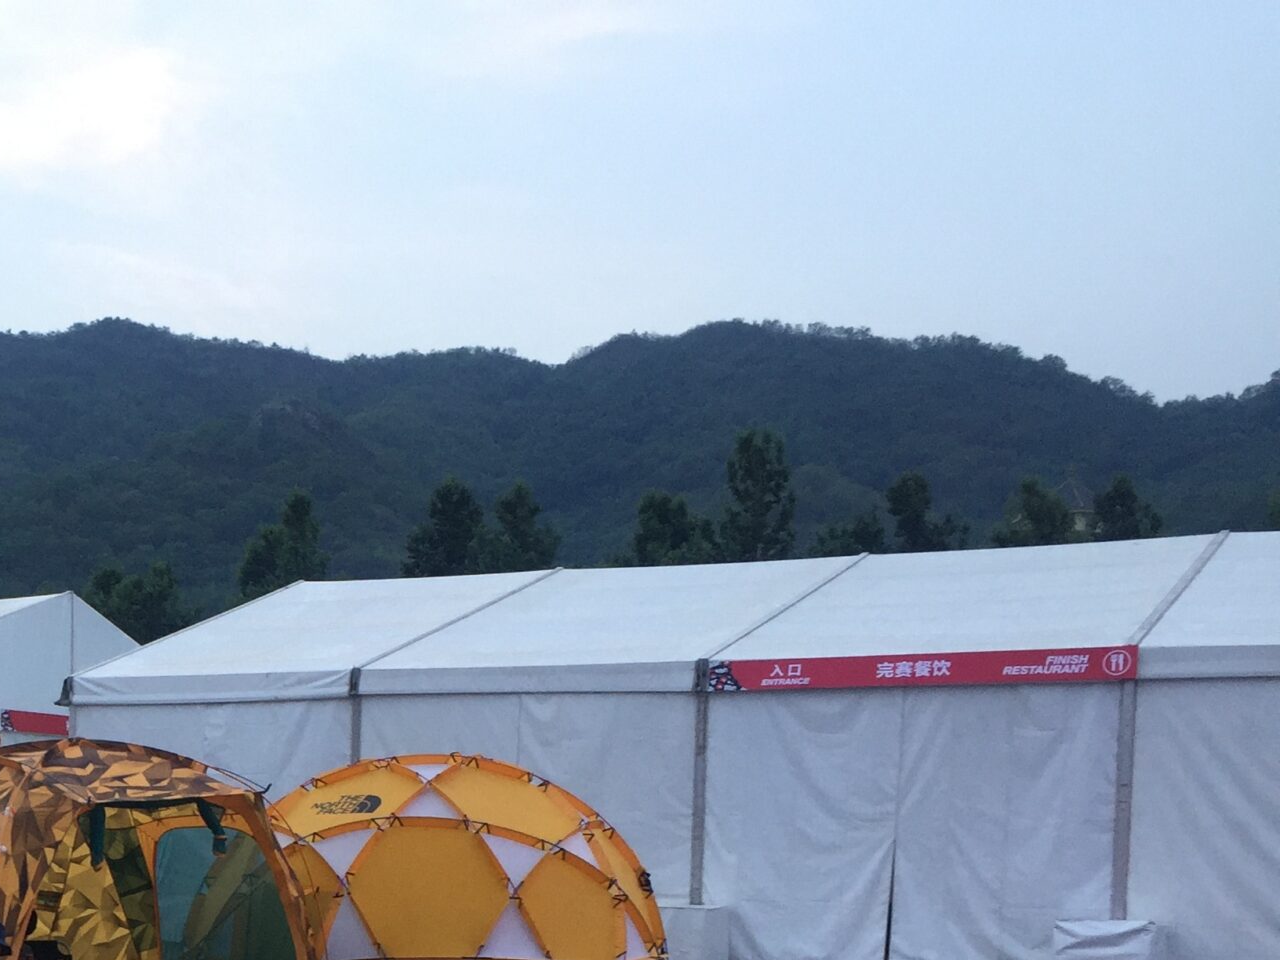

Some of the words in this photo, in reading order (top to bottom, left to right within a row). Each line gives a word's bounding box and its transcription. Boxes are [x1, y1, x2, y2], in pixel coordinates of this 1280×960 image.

[1045, 654, 1090, 666] FINISH
[769, 663, 802, 677] 入口
[876, 659, 951, 679] 完赛餐饮
[1002, 663, 1089, 676] RESTAURANT
[760, 677, 811, 686] ENTRANCE
[338, 794, 365, 802] THE
[311, 801, 358, 810] NORTH
[316, 807, 354, 815] FACE
